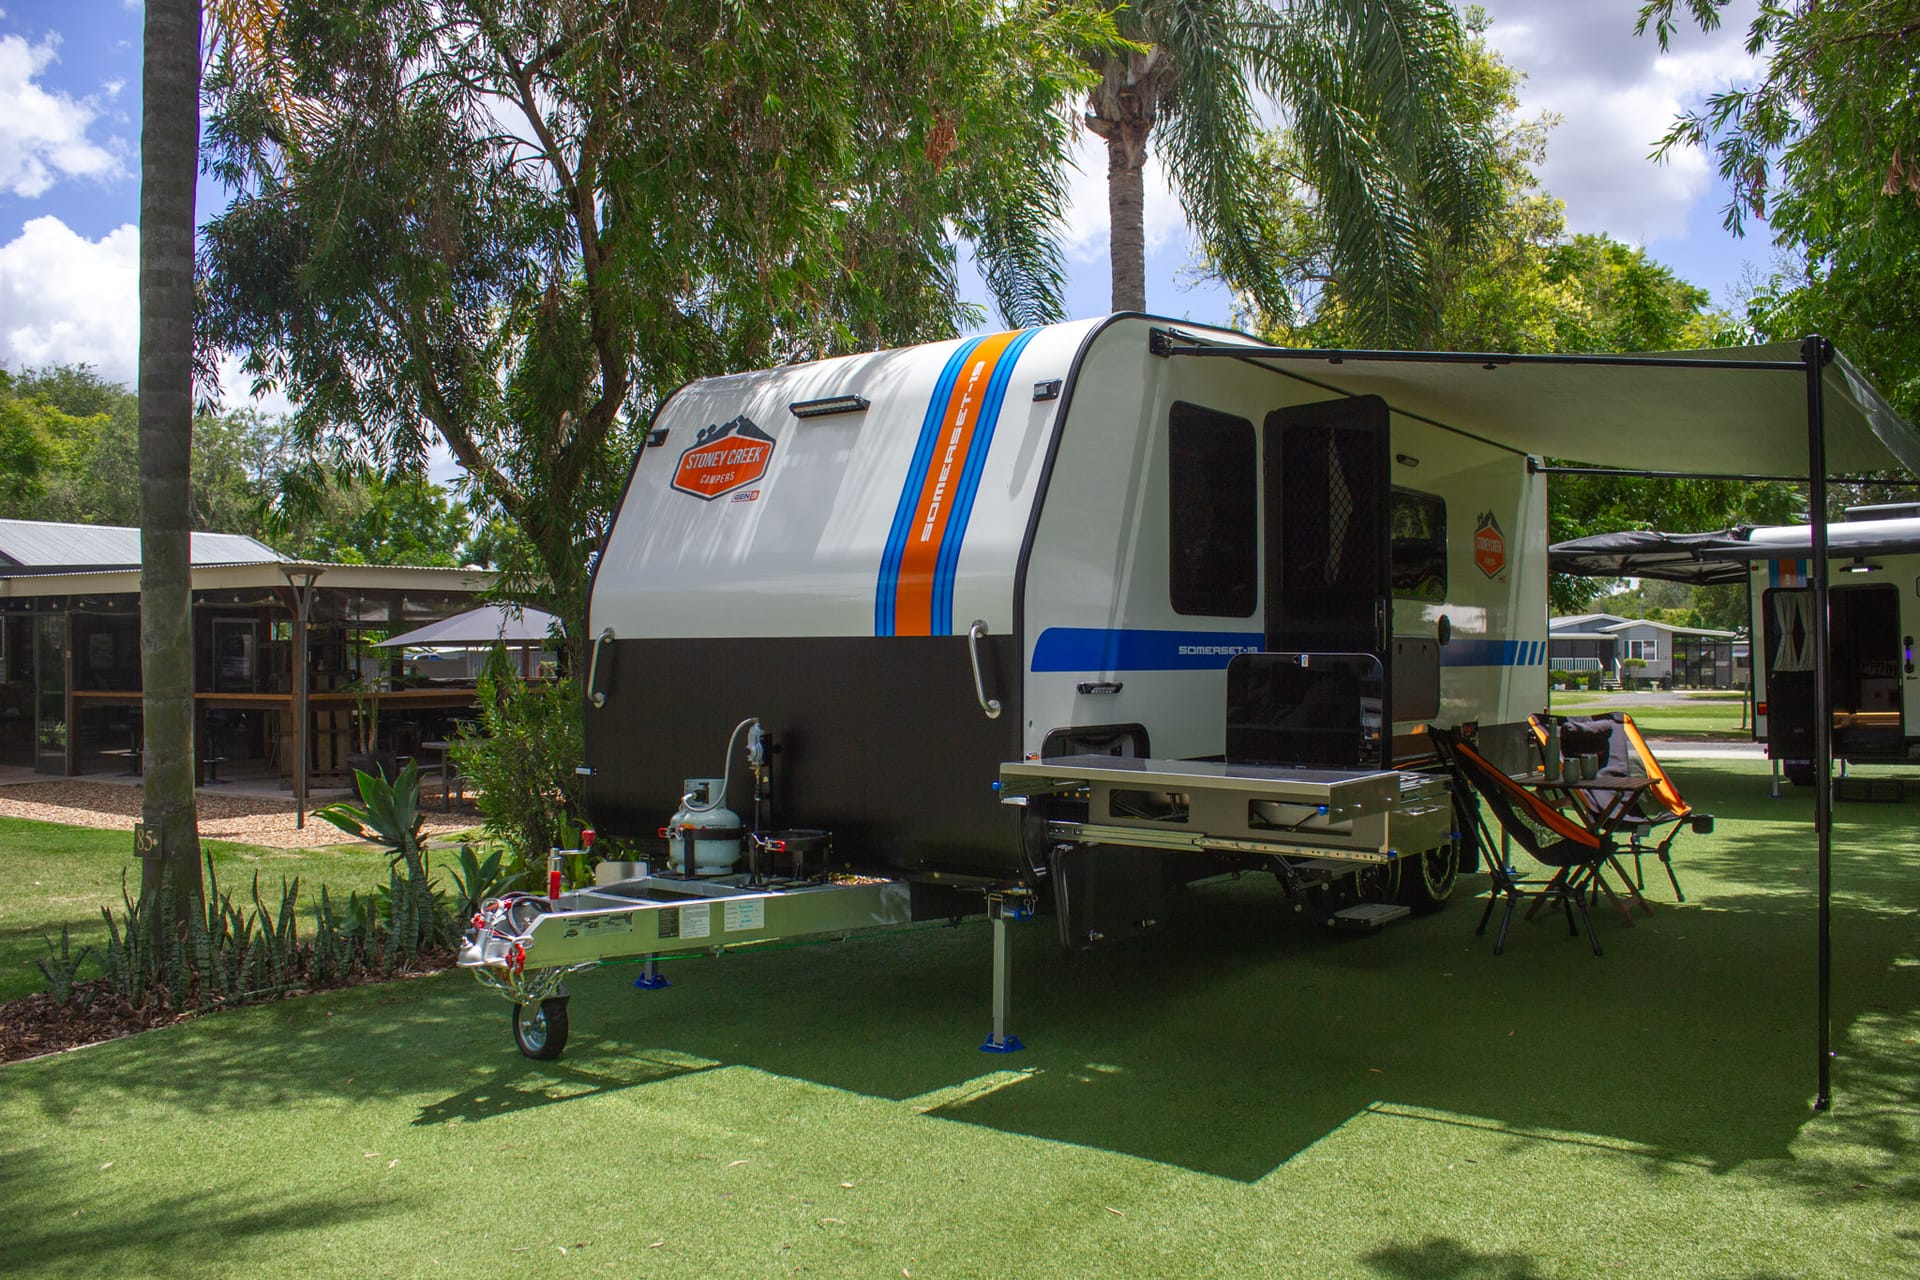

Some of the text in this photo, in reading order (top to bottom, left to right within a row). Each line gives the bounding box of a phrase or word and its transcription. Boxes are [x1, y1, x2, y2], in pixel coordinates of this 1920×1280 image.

[686, 447, 764, 470] STONEY CREEK
[699, 472, 735, 484] CAMPERS
[136, 829, 153, 851] 85
